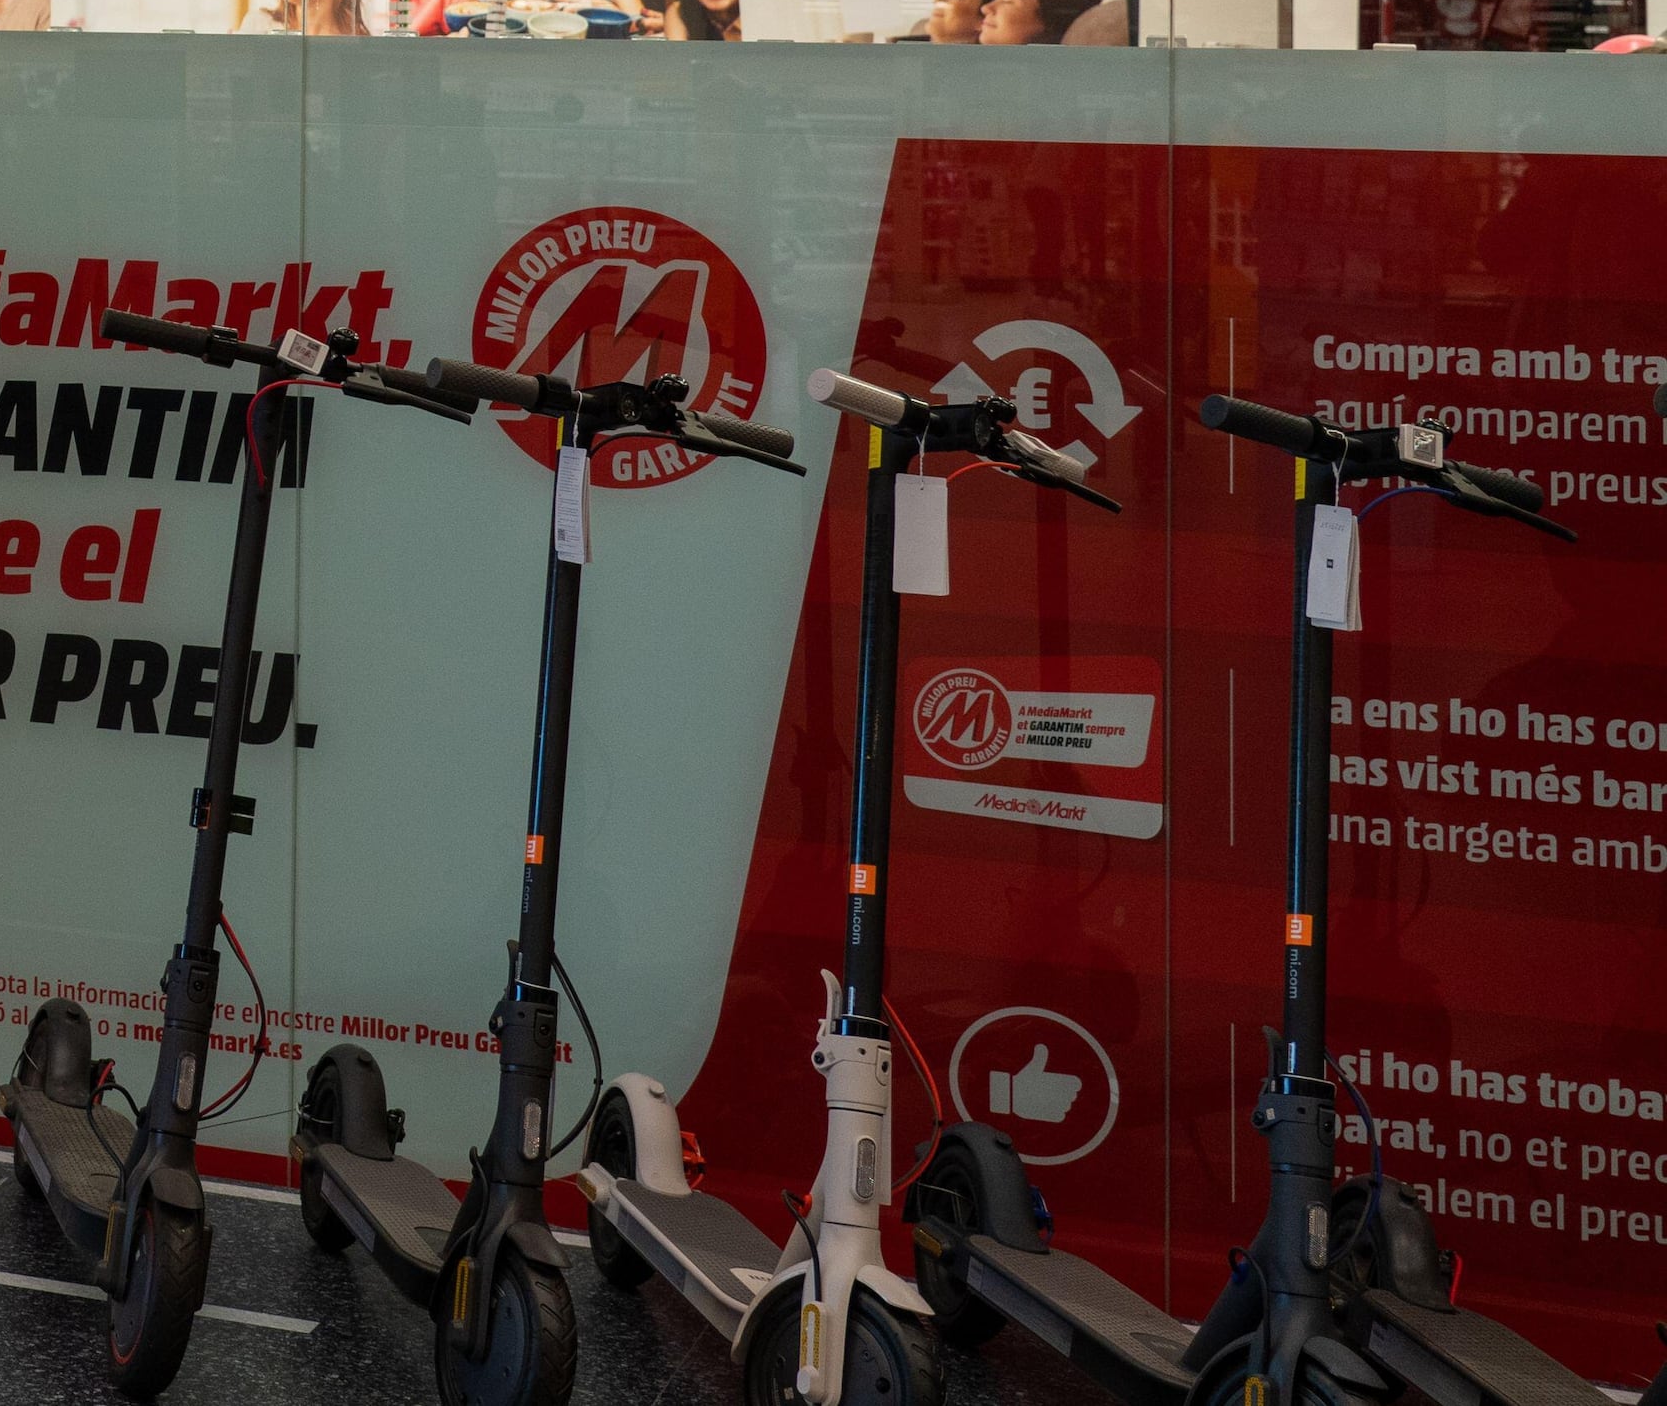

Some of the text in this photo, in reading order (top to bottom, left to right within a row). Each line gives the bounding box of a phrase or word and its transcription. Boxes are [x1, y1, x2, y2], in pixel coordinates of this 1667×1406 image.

[485, 219, 657, 344] MILLOR PREU
[1313, 335, 1481, 381] Compra
[1491, 344, 1591, 381] amb
[1550, 470, 1667, 506] preus
[60, 508, 162, 603] el
[30, 632, 318, 748] PREU.
[921, 676, 977, 719] MILLOR PREU
[1018, 705, 1093, 719] A MediaMarkt
[962, 727, 1009, 764] GARANTIT
[1015, 734, 1092, 749] el MILLOR PREU
[1017, 720, 1125, 737] et GARANTIM sempre
[1364, 697, 1439, 732] ens
[1450, 698, 1506, 737] ho
[1518, 703, 1595, 745] has
[1606, 718, 1667, 752] co
[1397, 755, 1479, 795] vist
[1491, 764, 1582, 804] més
[1404, 816, 1558, 863] targeta
[1571, 835, 1667, 873] amb
[852, 897, 865, 945] mi.com
[1289, 948, 1302, 999] mi.com
[11, 1005, 29, 1026] al
[98, 1021, 110, 1036] o
[116, 1023, 128, 1038] a
[33, 976, 51, 998] la
[241, 1003, 260, 1025] el
[267, 1009, 335, 1035] nostre
[340, 1014, 411, 1042] Millor
[415, 1022, 469, 1051] Preu
[1338, 1049, 1667, 1122] si ho has troba
[1459, 1129, 1512, 1163] no
[1526, 1136, 1567, 1171] et
[1529, 1194, 1565, 1231] el
